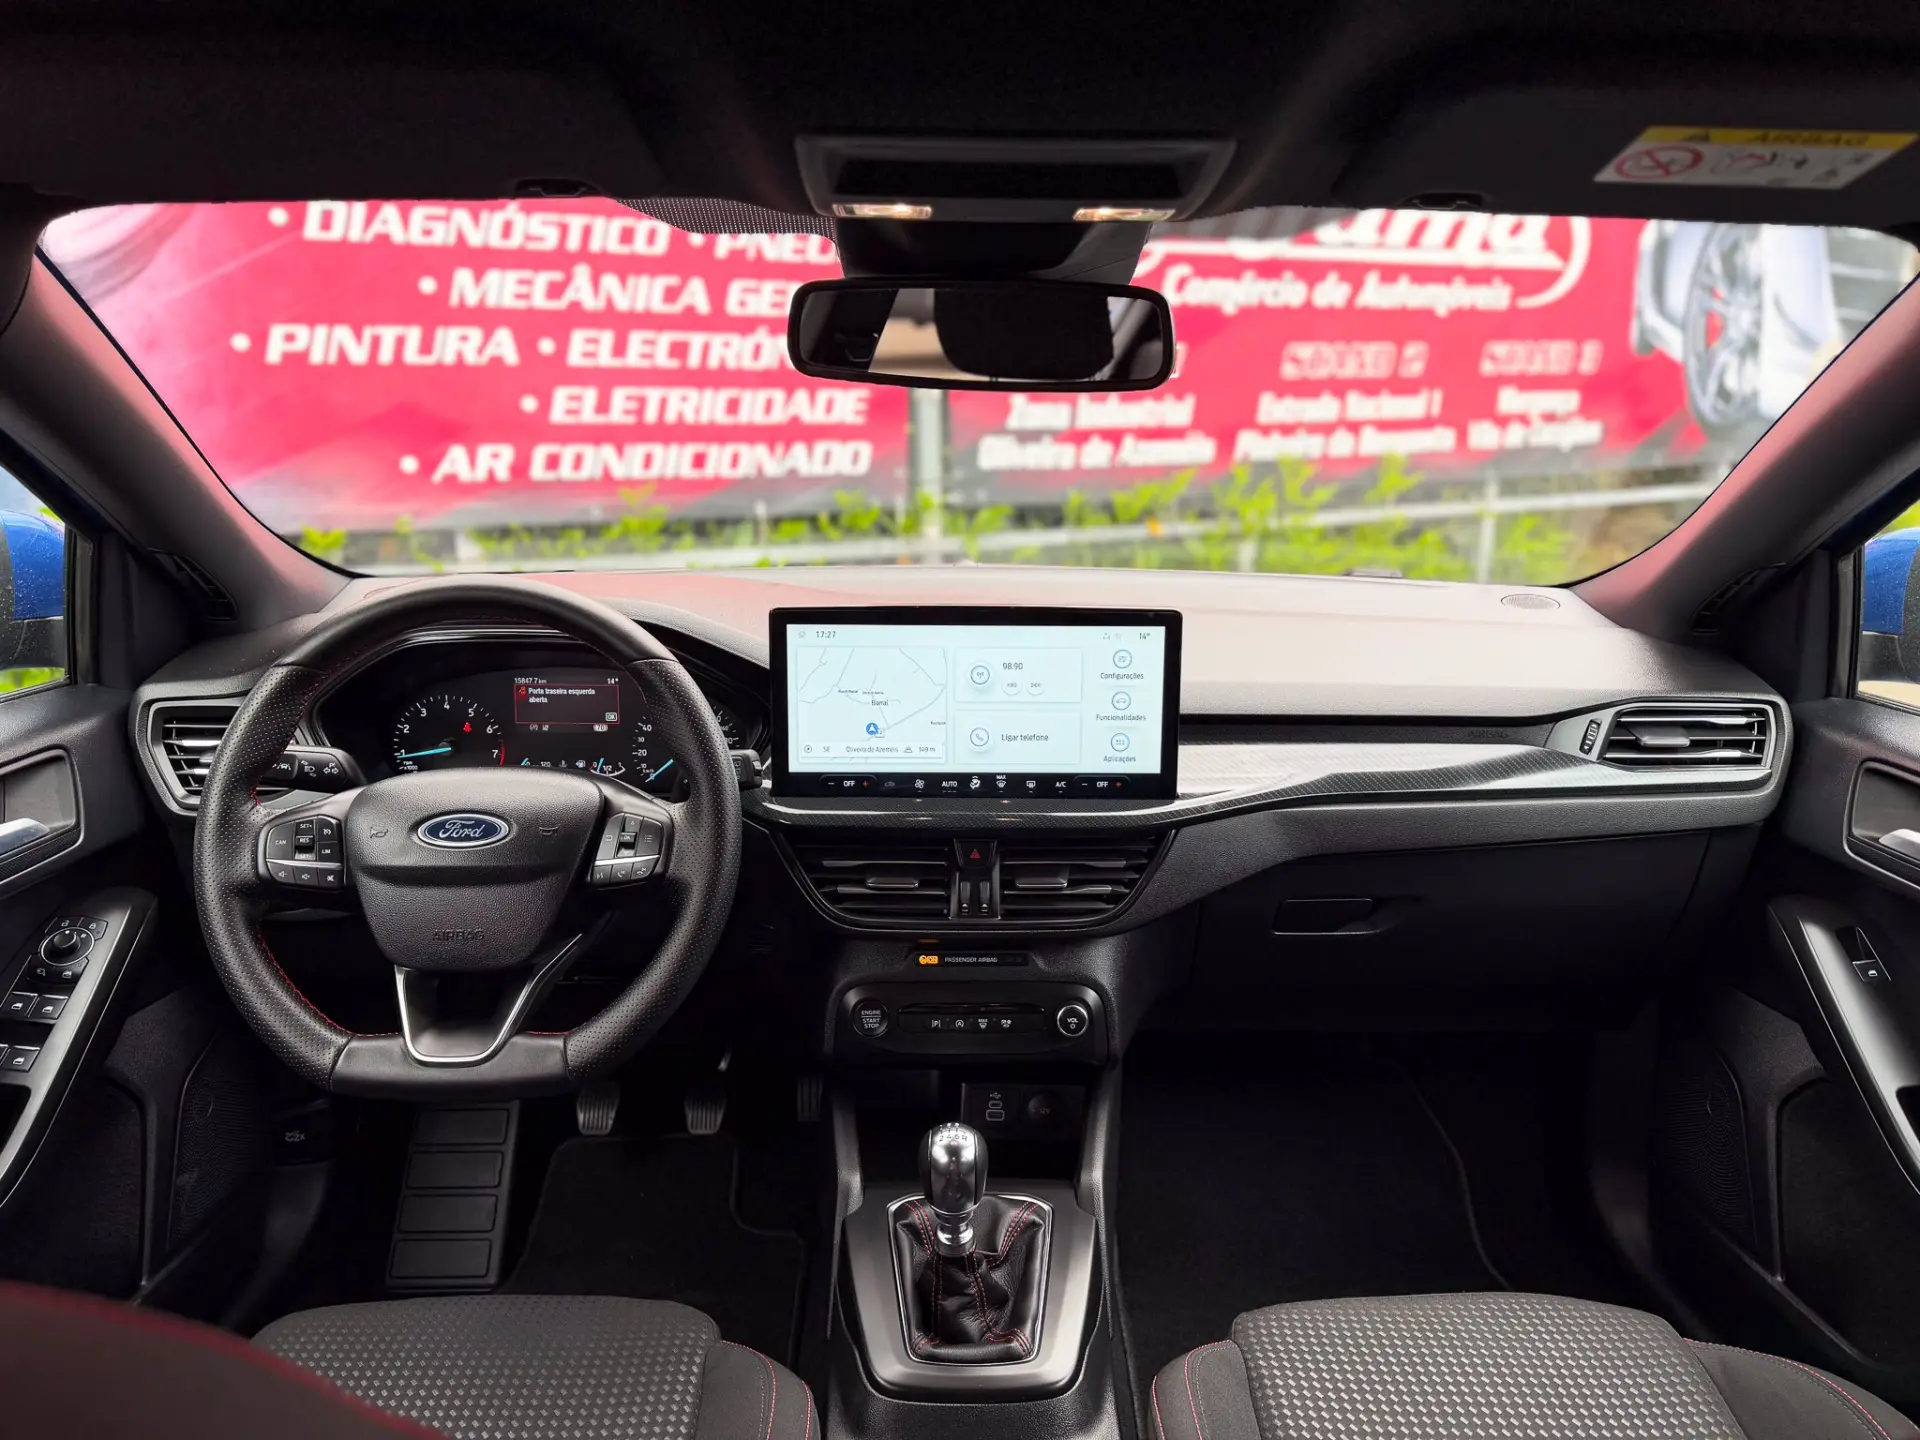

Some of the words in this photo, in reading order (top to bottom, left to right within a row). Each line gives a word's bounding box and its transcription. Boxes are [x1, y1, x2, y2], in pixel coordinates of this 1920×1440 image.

[302, 200, 671, 256] DIAGNÓSTICO
[448, 263, 712, 316] MECÂNICA
[724, 278, 801, 317] GE
[263, 323, 520, 367] PINTURA
[549, 385, 870, 425] ELETRICIDADE
[431, 442, 515, 484] AR
[529, 439, 872, 482] CONDICIONADO
[815, 630, 837, 639] 17:27
[1002, 662, 1024, 670] 98.90
[1099, 672, 1144, 681] Configurações
[528, 687, 544, 695] Porta
[545, 687, 567, 695] traseira
[568, 687, 596, 696] esquerda
[443, 701, 450, 709] 4
[420, 708, 427, 717] 3
[468, 708, 475, 717] 5
[1096, 713, 1147, 721] Funcionalidades
[403, 724, 410, 733] 2
[486, 724, 493, 734] 6
[1001, 733, 1019, 743] Ligar
[1020, 733, 1049, 742] telefone
[491, 749, 499, 758] 7
[1103, 755, 1136, 763] Aplicações
[439, 820, 485, 838] Ford
[433, 929, 485, 941] AIRBAG
